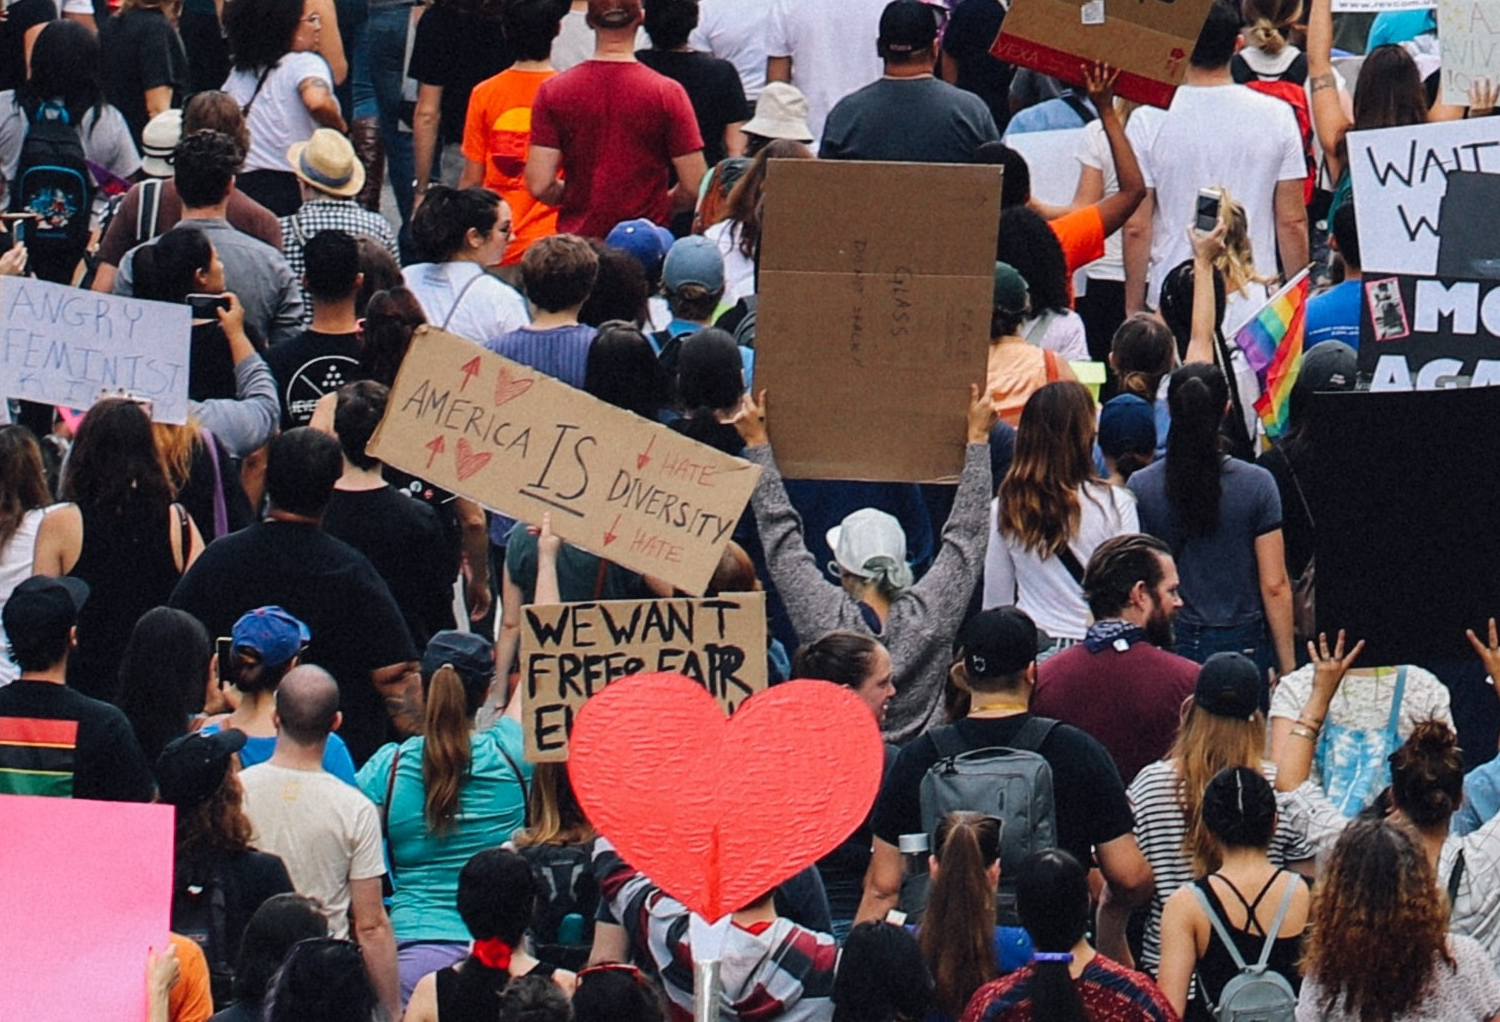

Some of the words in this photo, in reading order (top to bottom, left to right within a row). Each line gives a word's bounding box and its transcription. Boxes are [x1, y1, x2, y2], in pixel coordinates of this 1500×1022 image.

[1368, 142, 1500, 187] WAIT
[9, 286, 143, 341] ANGRY
[3, 329, 181, 394] FEMINIST
[403, 381, 531, 459] AMERICA
[526, 423, 599, 503] IS
[607, 467, 734, 544] DIVERSITY
[662, 453, 718, 486] HATE
[526, 606, 597, 648] WE
[601, 601, 741, 644] WANT
